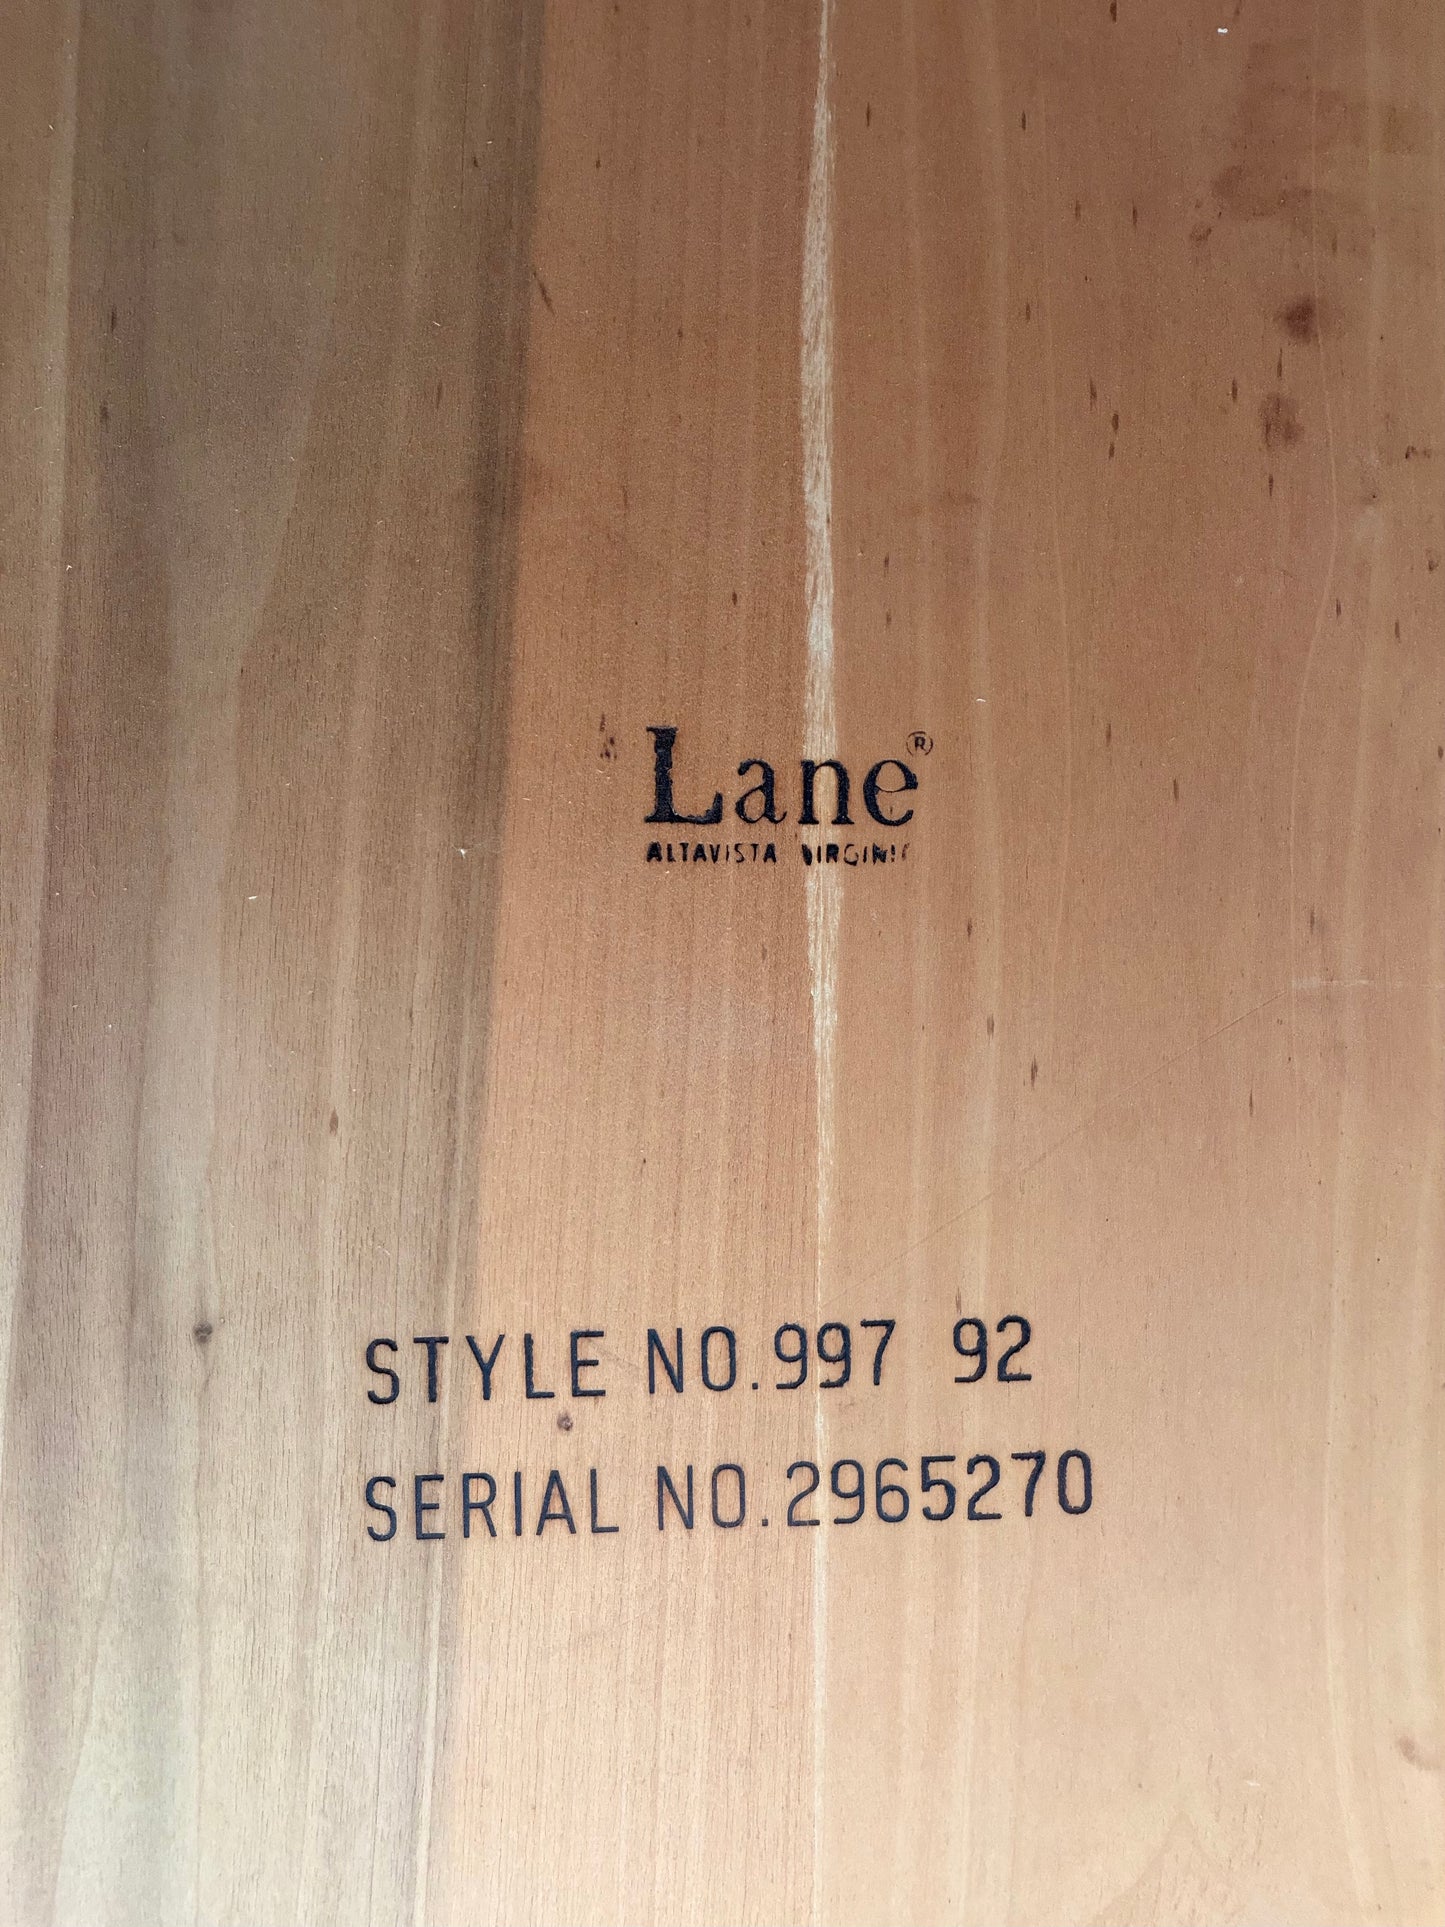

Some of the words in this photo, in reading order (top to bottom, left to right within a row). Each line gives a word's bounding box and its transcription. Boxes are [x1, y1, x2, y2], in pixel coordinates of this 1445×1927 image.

[646, 841, 777, 864] ALTAVISTA
[365, 1329, 606, 1405] STYLE
[952, 1315, 1032, 1383] 92
[365, 1469, 620, 1542] SERIAL
